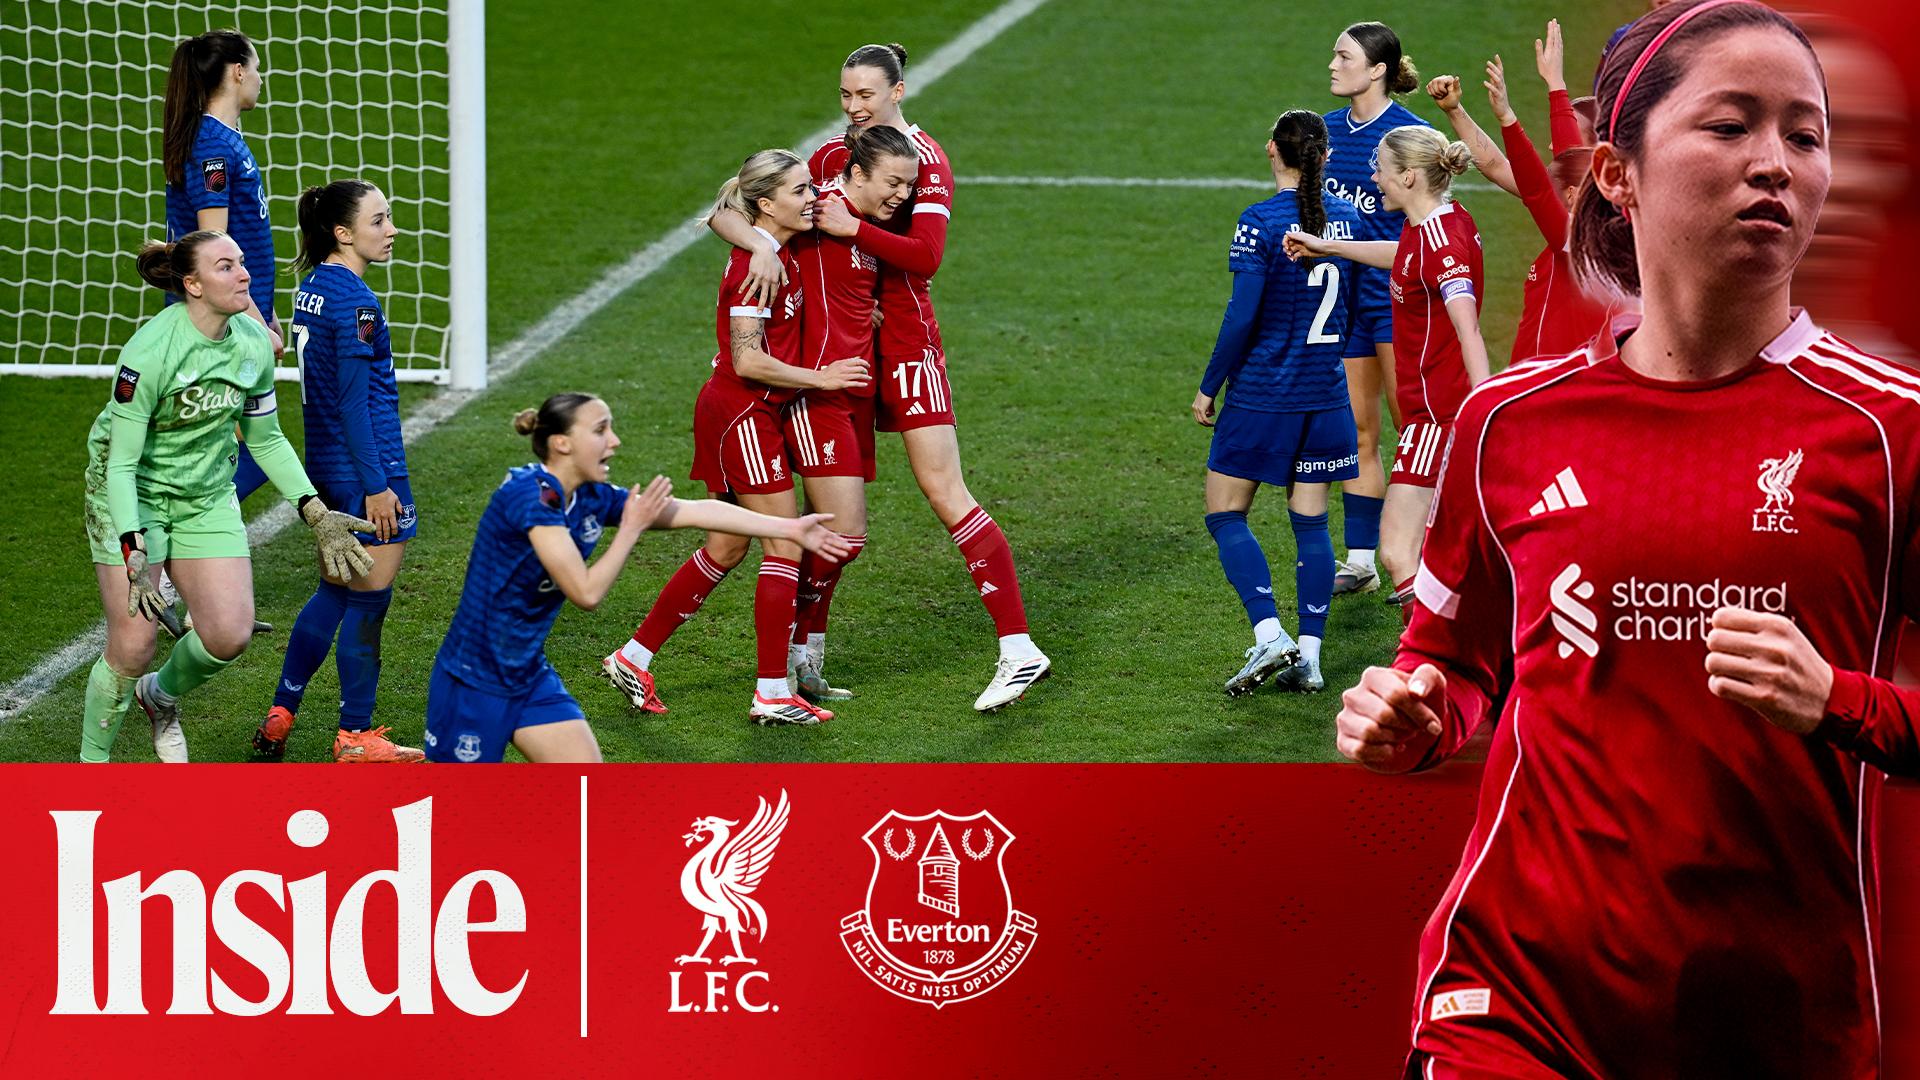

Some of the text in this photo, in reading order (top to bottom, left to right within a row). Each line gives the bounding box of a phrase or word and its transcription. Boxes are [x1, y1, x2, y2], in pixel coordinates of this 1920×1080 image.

[916, 185, 949, 197] Expeda
[1325, 177, 1376, 214] Stake
[1306, 262, 1340, 345] 2
[892, 361, 924, 399] 17
[179, 385, 241, 420] Stake
[1295, 453, 1359, 474] ggm gastr
[1752, 514, 1799, 535] L.F.C.
[1611, 576, 1787, 613] standard
[1613, 609, 1713, 642] chart
